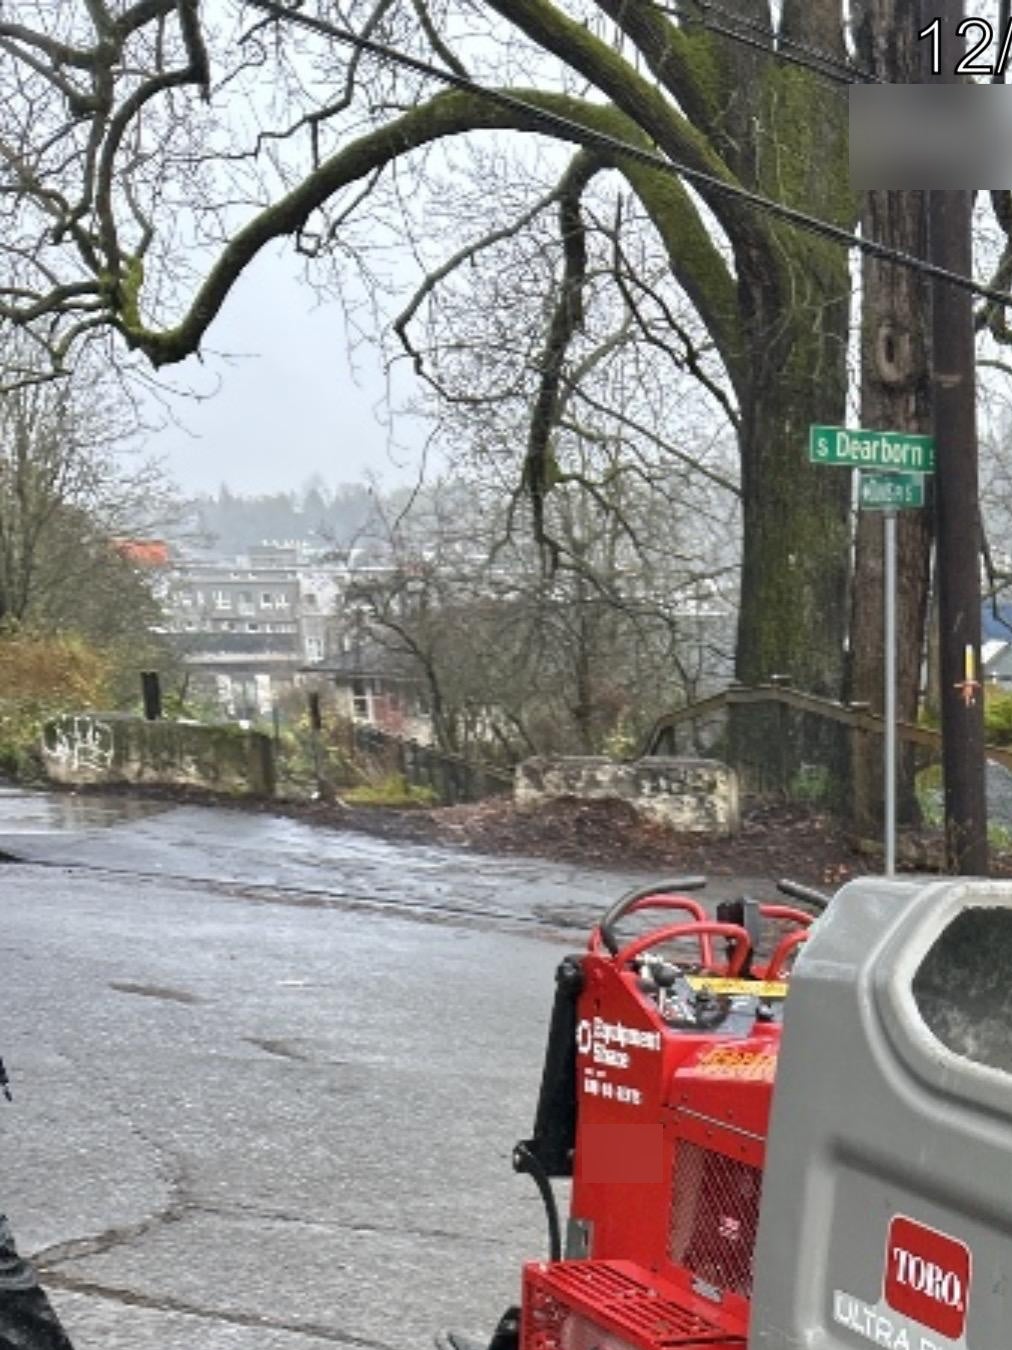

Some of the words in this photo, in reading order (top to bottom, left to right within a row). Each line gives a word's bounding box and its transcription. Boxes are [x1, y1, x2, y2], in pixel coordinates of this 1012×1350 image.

[816, 437, 829, 457] S
[835, 431, 923, 467] Dearborn
[892, 1247, 963, 1308] TORO
